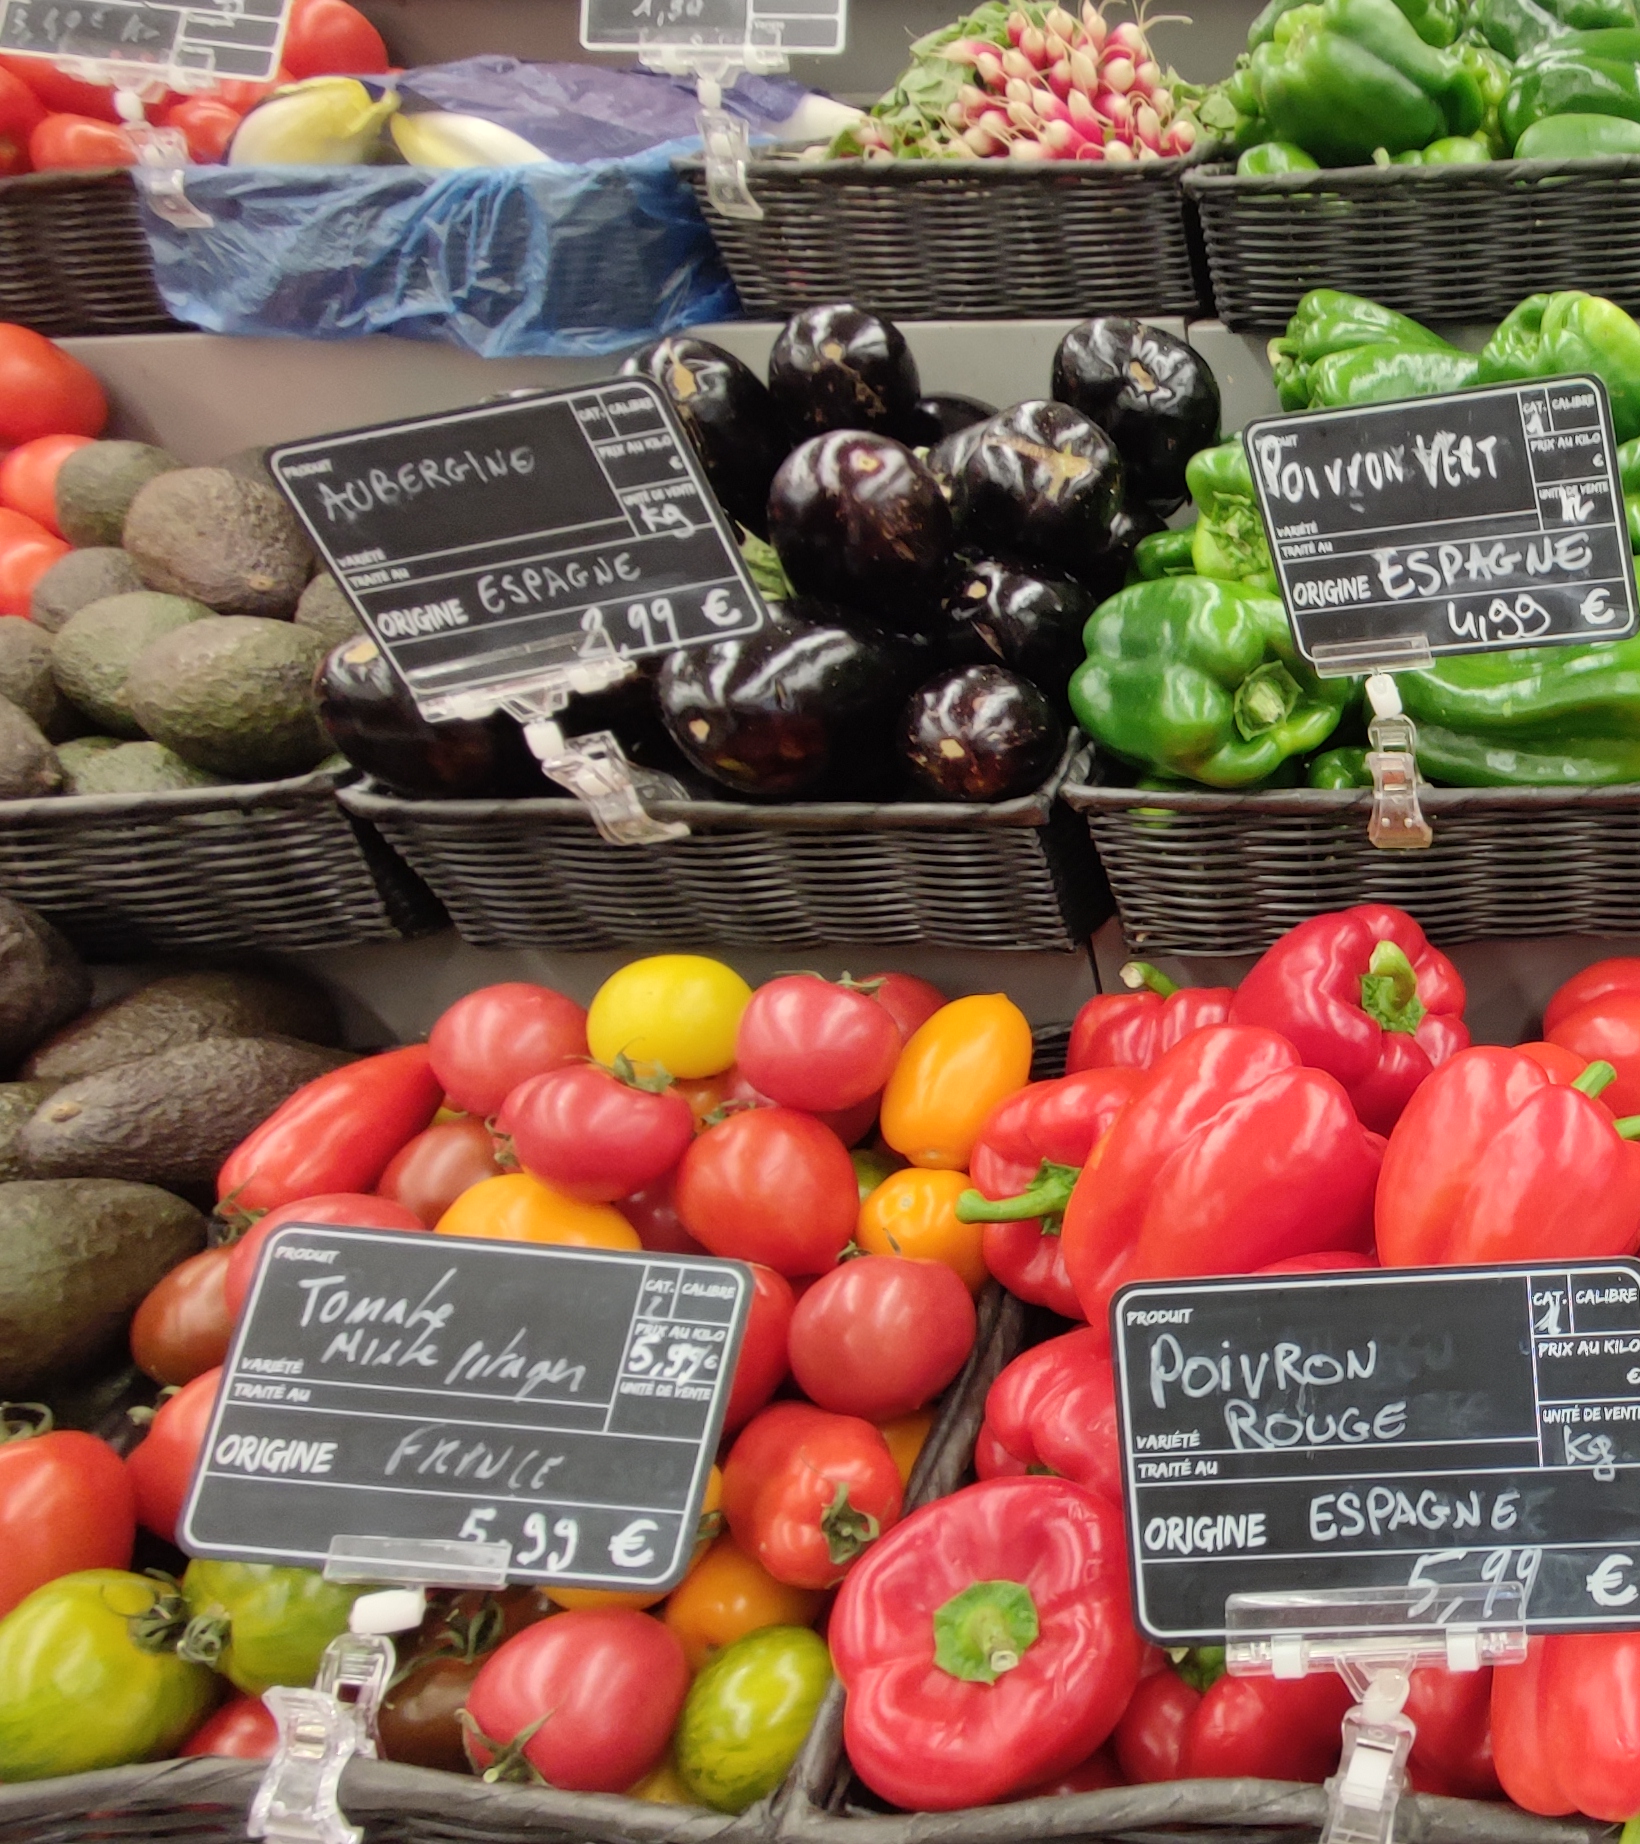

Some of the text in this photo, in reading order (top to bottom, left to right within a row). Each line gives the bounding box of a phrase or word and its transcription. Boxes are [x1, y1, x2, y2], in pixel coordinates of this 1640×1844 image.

[627, 441, 644, 454] AU
[1558, 436, 1573, 449] AU
[1575, 432, 1601, 446] KILO
[318, 447, 535, 522] AUBERGINE
[1293, 531, 1593, 608] ORIGINE ESPAGNE
[377, 552, 641, 637] ORIGINE ESPAGNE
[701, 588, 742, 627] €
[1447, 587, 1616, 642] 4,99 €
[275, 1245, 341, 1265] PRODUIT
[645, 1279, 736, 1300] CAT. CALIBRE
[1532, 1288, 1638, 1306] CAT. CALIBRE
[1126, 1308, 1194, 1326] PRODUIT
[668, 1325, 691, 1340] AU
[691, 1327, 726, 1342] KILO
[1538, 1338, 1640, 1358] PRIX AU KILO
[703, 1353, 719, 1370] €
[286, 1387, 312, 1402] AU
[655, 1384, 673, 1397] DE
[1224, 1398, 1408, 1450] ROUGE
[1542, 1404, 1581, 1424] UNITÉ
[1583, 1405, 1601, 1421] DE
[1136, 1429, 1200, 1450] VARIÉTÉ
[215, 1423, 566, 1490] ORIGINE FRANCE
[1138, 1457, 1218, 1478] TRAITÉ AU
[1144, 1486, 1522, 1554] ORIGINE ESPAGNE
[608, 1519, 659, 1568] €
[1407, 1547, 1639, 1624] 5,99 €
